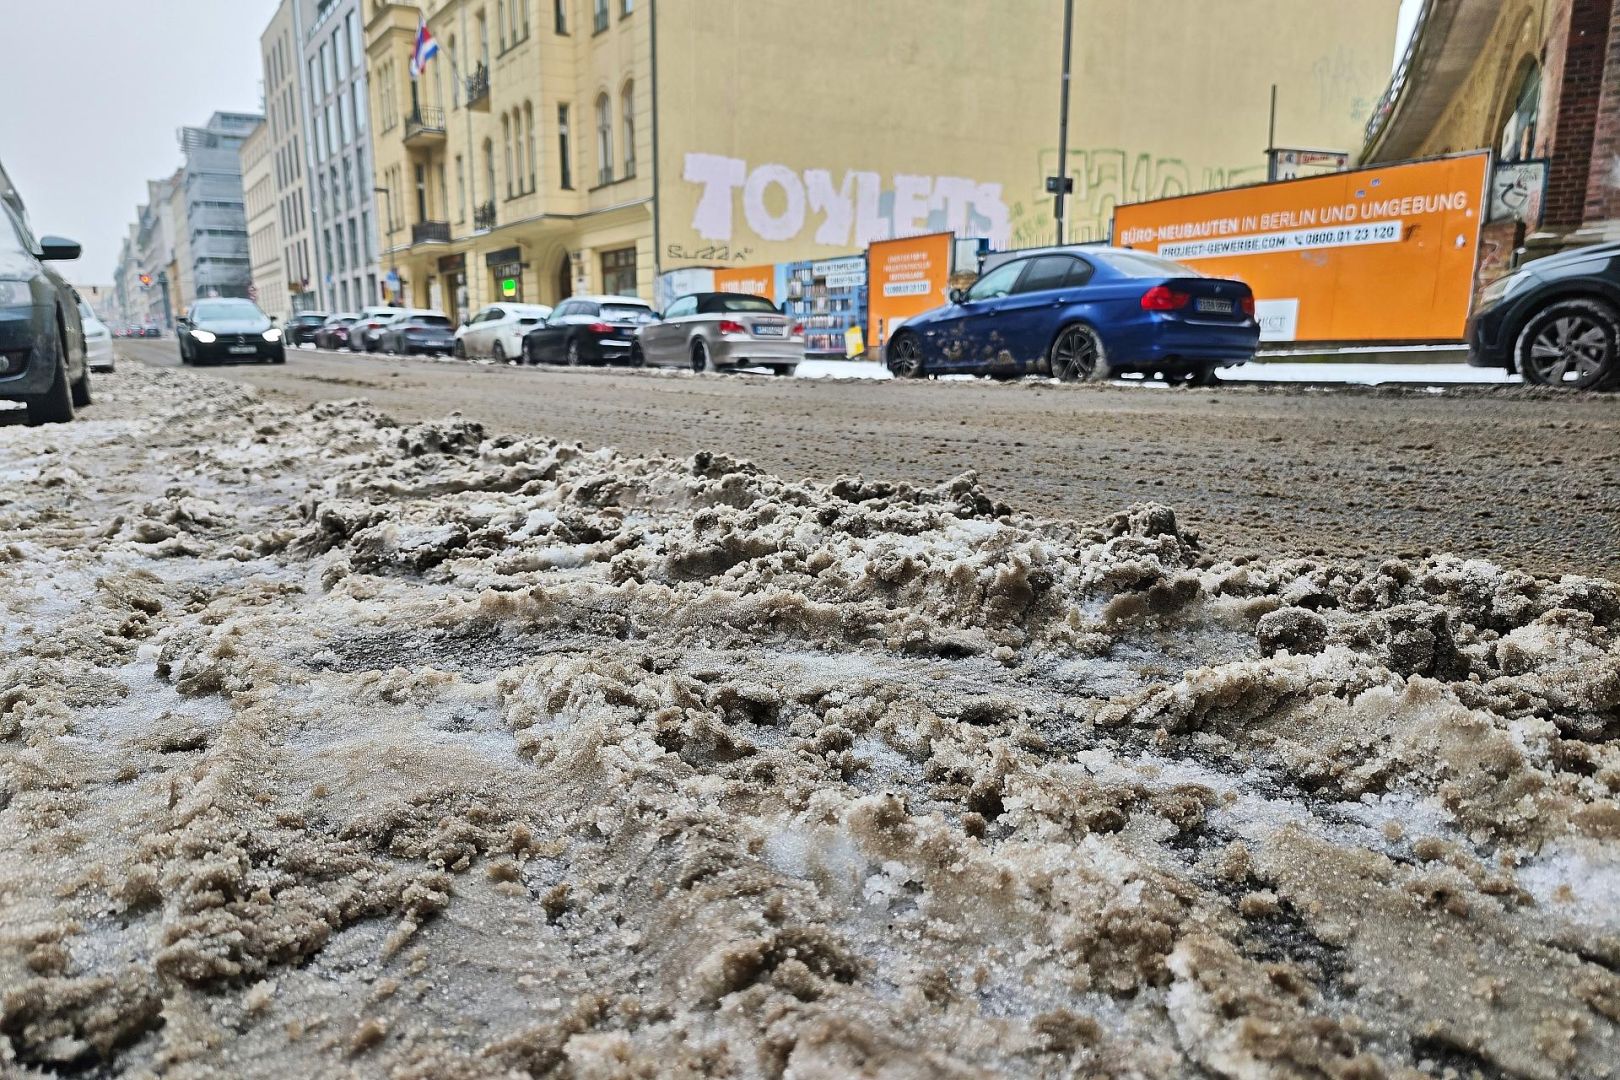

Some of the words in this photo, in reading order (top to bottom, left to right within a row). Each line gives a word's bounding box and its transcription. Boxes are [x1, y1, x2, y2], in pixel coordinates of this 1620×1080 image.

[1120, 216, 1239, 245] BÜRO-NEUBAUTEN
[1241, 215, 1257, 232] IN
[1260, 206, 1316, 229] BERLIN
[1320, 203, 1357, 223] UND
[1373, 226, 1394, 239] 120
